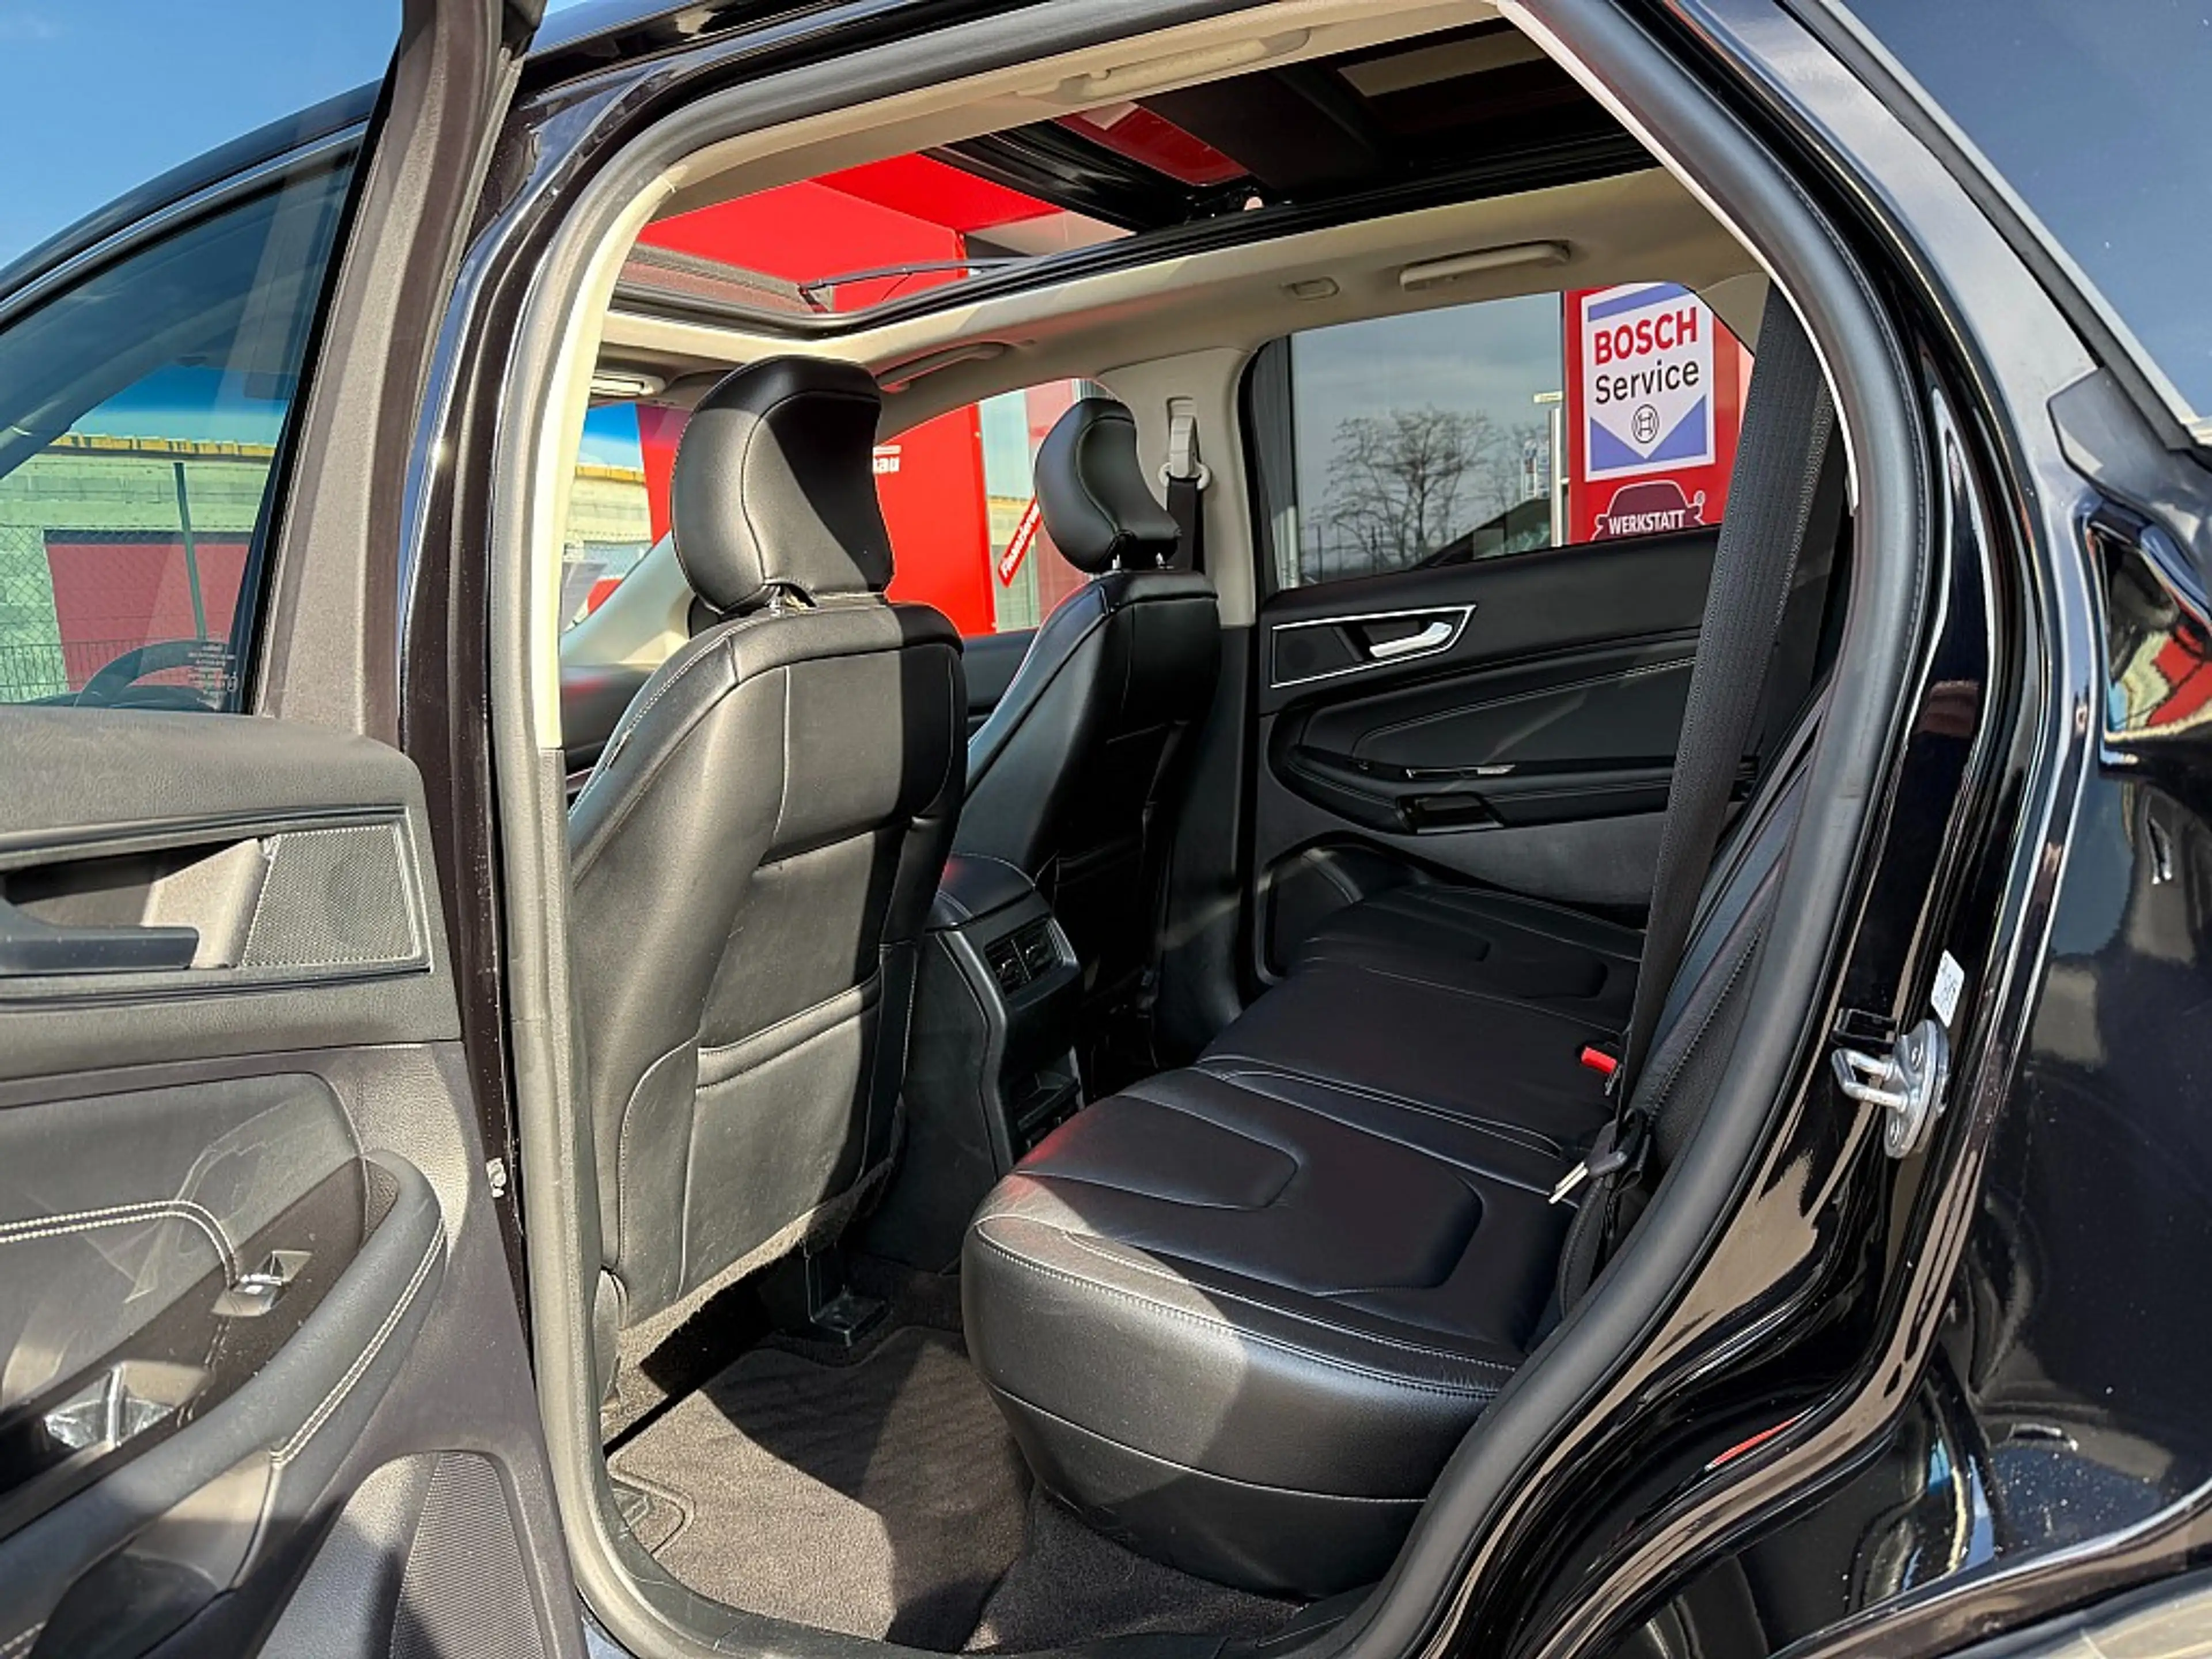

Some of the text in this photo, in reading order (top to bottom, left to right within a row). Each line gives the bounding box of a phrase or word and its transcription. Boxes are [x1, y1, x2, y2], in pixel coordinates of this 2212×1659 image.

[1594, 307, 1697, 365] BOSCH
[1596, 360, 1699, 404] Service
[1608, 509, 1685, 535] WERKSTATT
